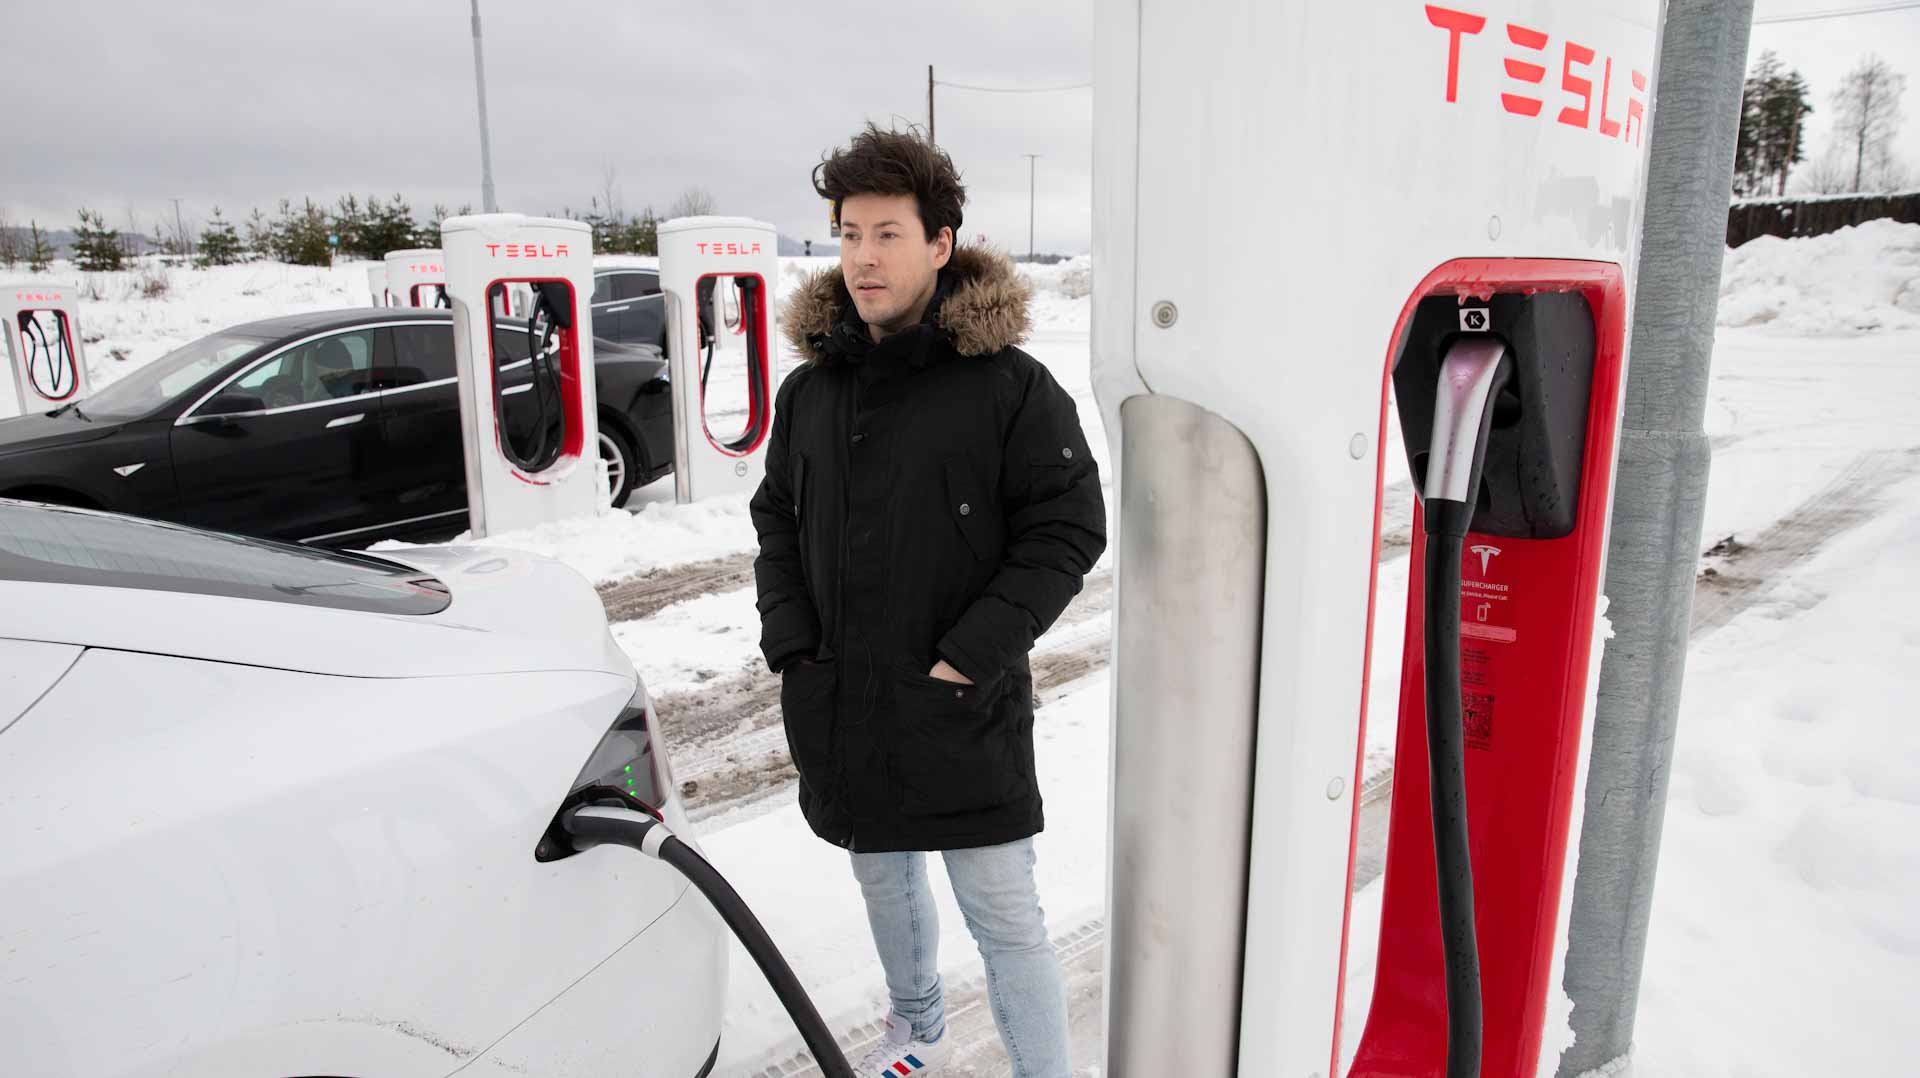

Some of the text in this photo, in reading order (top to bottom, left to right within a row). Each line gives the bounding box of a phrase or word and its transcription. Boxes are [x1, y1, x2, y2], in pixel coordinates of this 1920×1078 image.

[1424, 4, 1647, 149] TESLA
[485, 244, 569, 258] TESLA
[696, 242, 761, 256] TESLA
[1470, 315, 1481, 325] K
